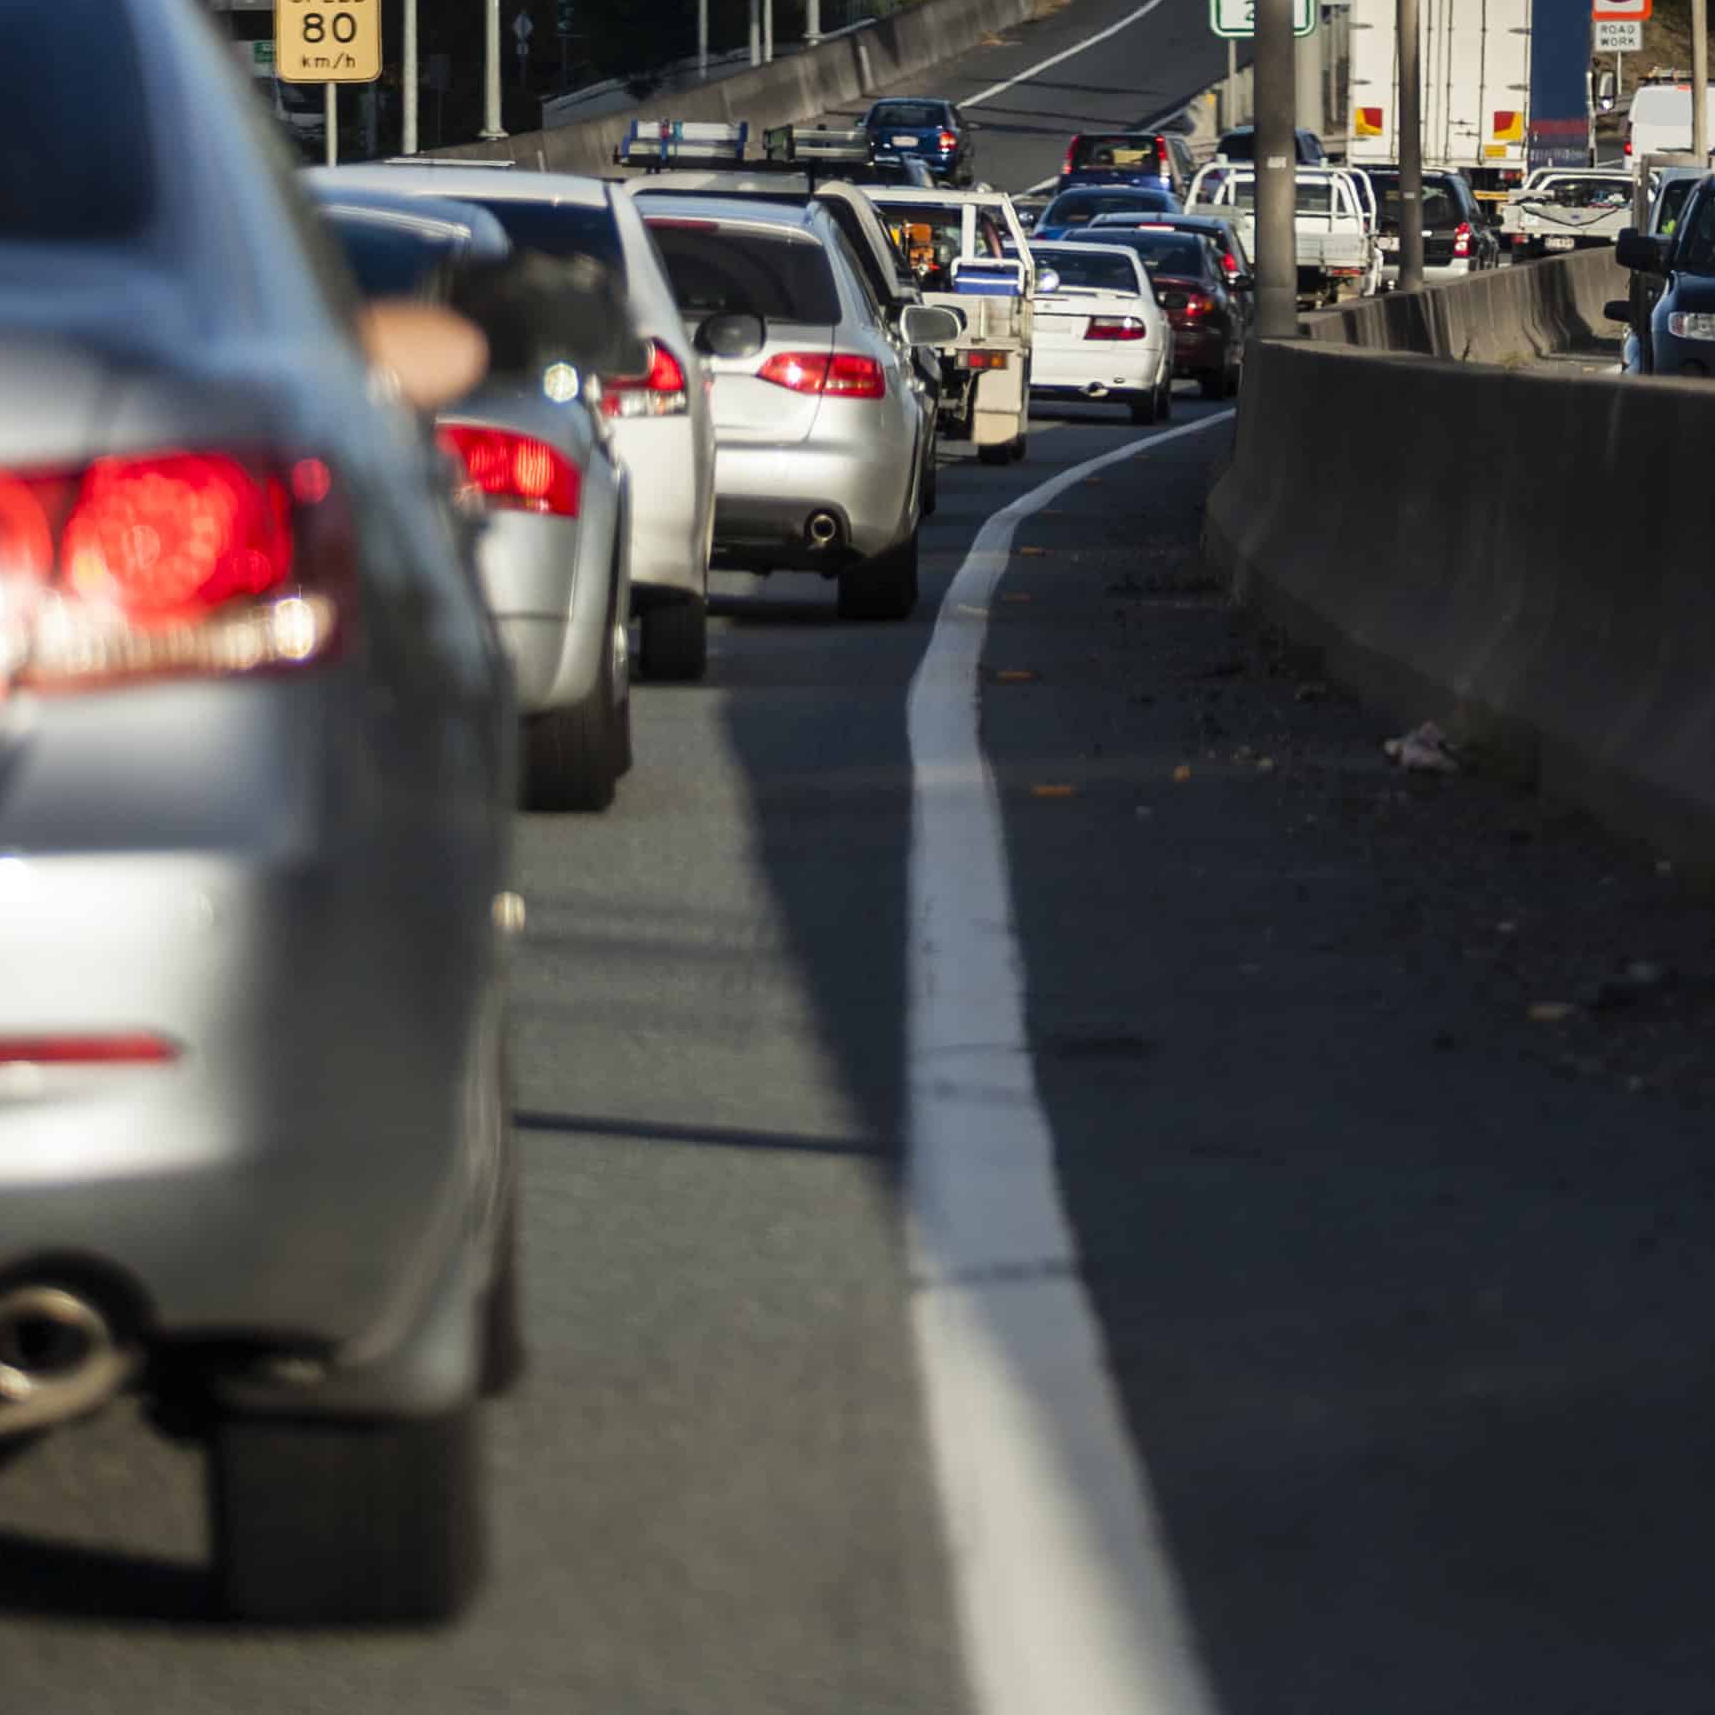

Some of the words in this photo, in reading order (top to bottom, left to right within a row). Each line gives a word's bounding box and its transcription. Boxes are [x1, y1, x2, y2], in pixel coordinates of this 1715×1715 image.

[302, 12, 357, 43] 80
[1600, 25, 1636, 35] ROAD
[1600, 37, 1636, 47] WORK
[301, 53, 356, 69] km/h
